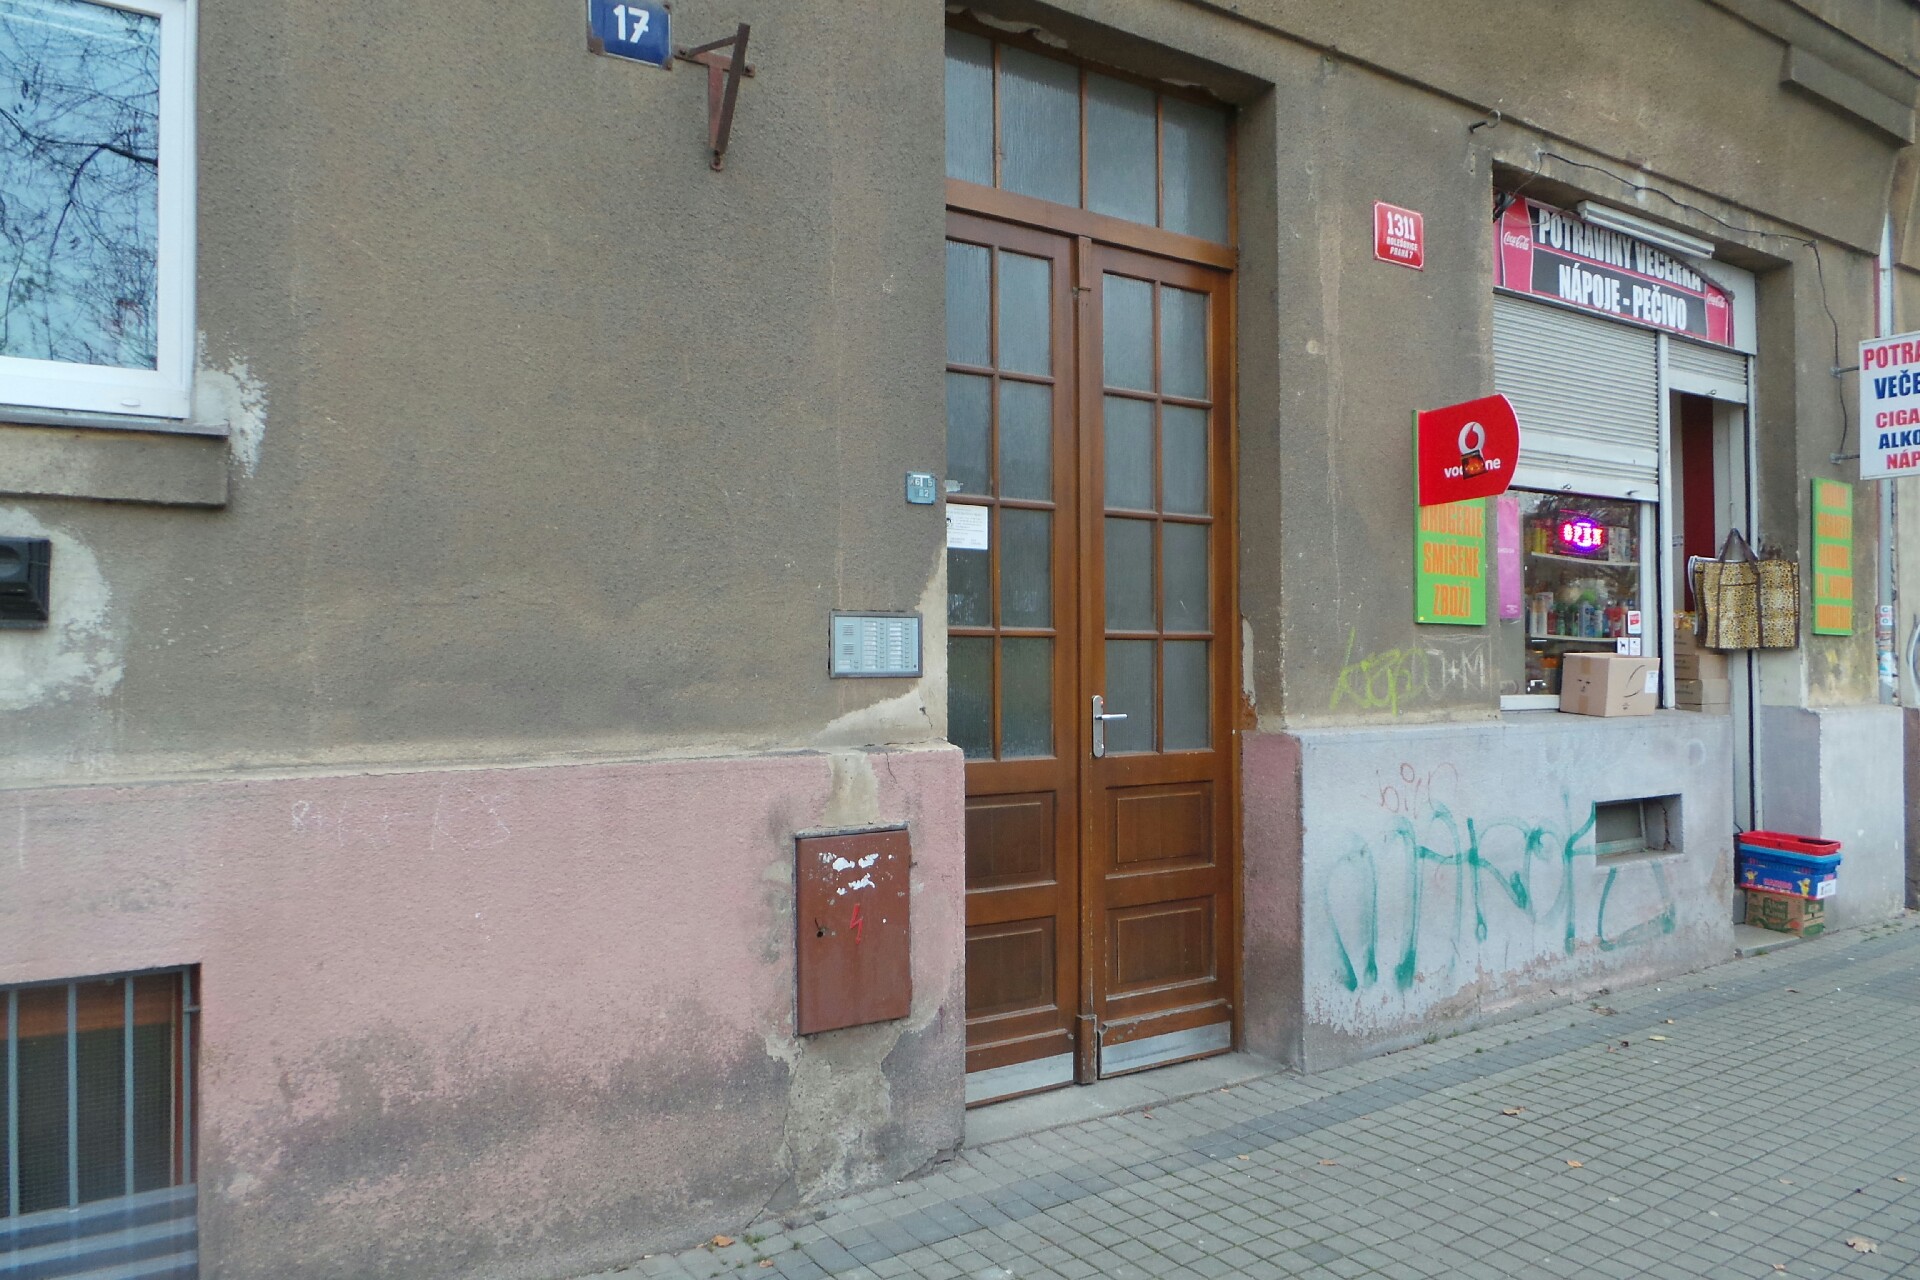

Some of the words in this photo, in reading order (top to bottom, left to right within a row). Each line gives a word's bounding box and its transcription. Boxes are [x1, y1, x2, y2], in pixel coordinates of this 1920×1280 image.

[613, 4, 650, 43] 17
[1387, 211, 1415, 240] 1311
[1538, 208, 1632, 269] POTRAVINY
[1390, 246, 1409, 258] PRAHA
[1408, 250, 1414, 259] 7
[1559, 262, 1621, 313] NÁPOJE
[1632, 284, 1687, 330] PEČIVO
